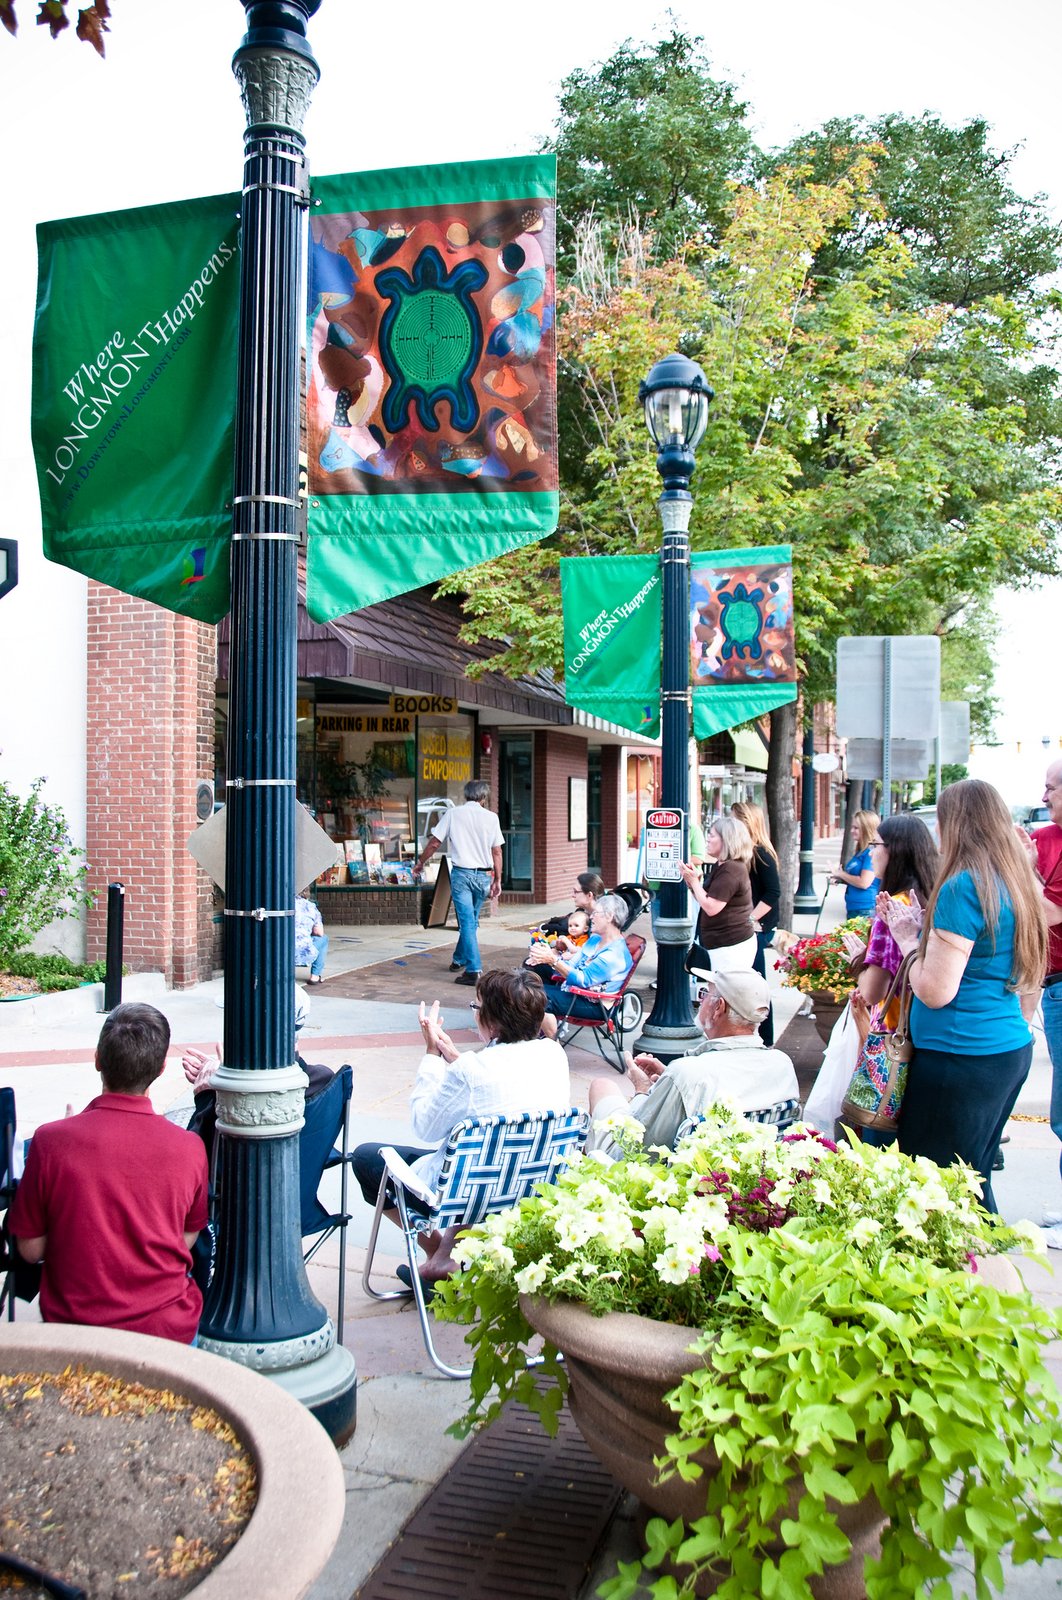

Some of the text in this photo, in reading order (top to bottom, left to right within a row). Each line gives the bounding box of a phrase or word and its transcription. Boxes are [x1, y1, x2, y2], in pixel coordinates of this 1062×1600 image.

[45, 241, 237, 485] LONGMONT Happens.
[62, 331, 126, 406] Where
[579, 609, 608, 642] Where
[568, 606, 624, 674] LONGMONT
[394, 696, 453, 713] BOOKS
[315, 715, 410, 733] PARKING IN REAR
[423, 757, 471, 781] EMPORIUM
[651, 814, 677, 824] CAUTION
